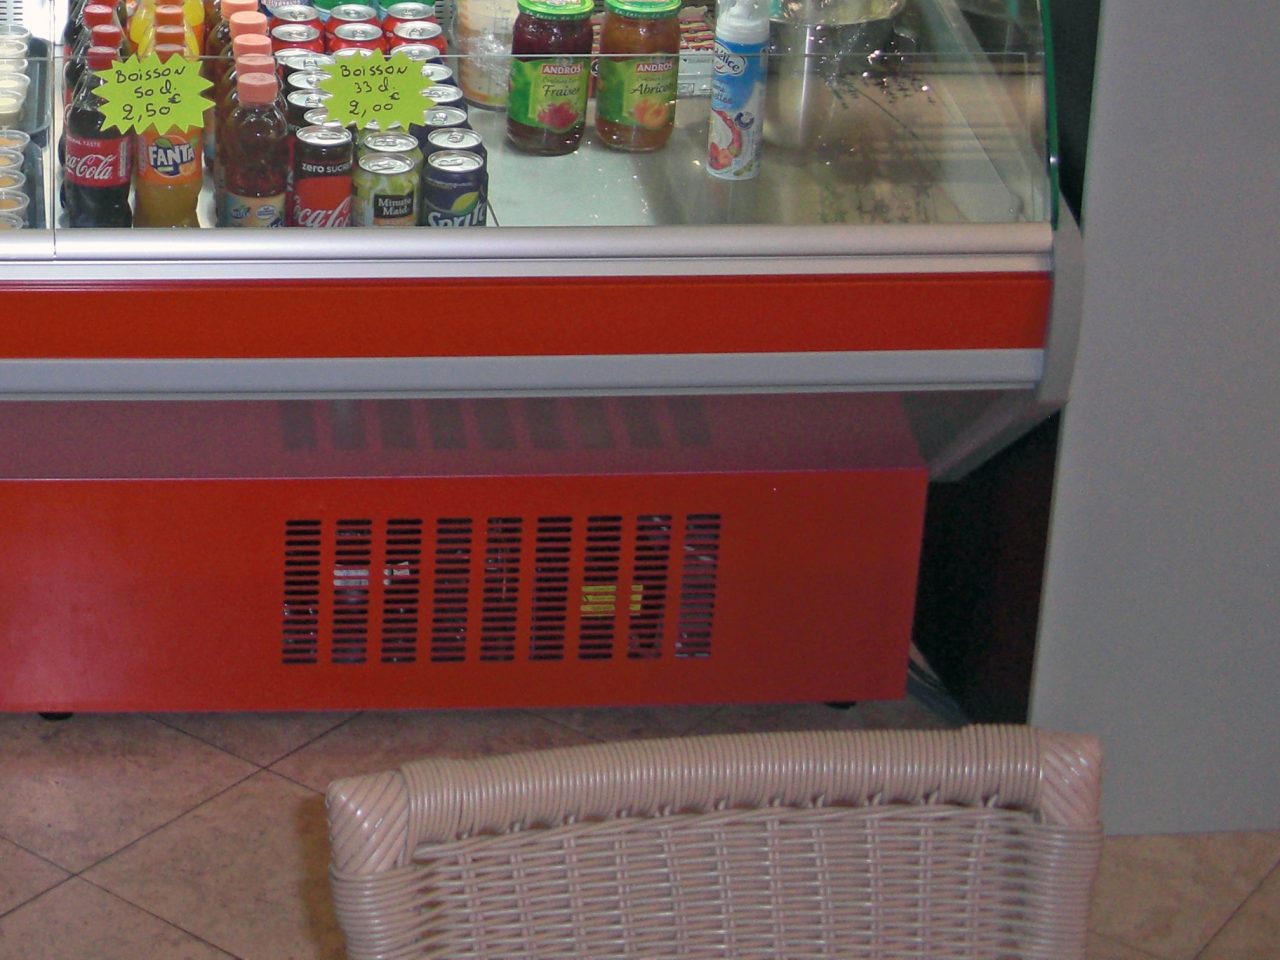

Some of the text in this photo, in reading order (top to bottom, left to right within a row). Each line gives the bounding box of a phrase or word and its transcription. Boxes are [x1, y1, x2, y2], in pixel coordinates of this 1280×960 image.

[543, 64, 581, 74] ANDROS
[637, 63, 673, 73] ANDROS
[148, 143, 195, 166] FANTA
[301, 162, 325, 173] zero
[378, 198, 411, 208] Minute
[382, 205, 408, 215] Maid
